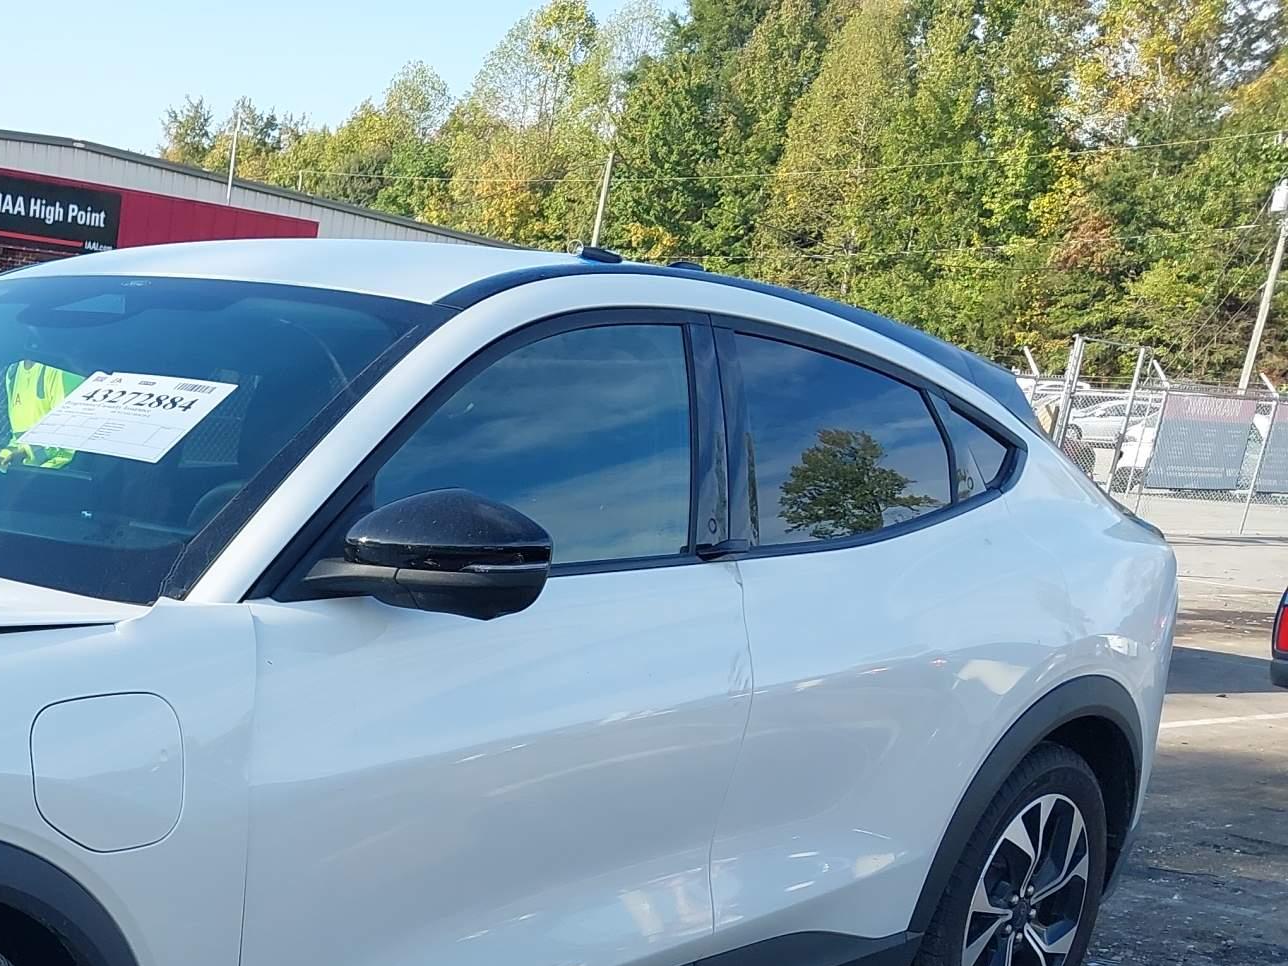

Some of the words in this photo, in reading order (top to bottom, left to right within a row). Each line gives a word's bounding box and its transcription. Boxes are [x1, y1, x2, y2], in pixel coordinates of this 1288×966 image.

[29, 196, 63, 225] High
[67, 203, 106, 228] Point
[82, 388, 199, 412] 43272884
